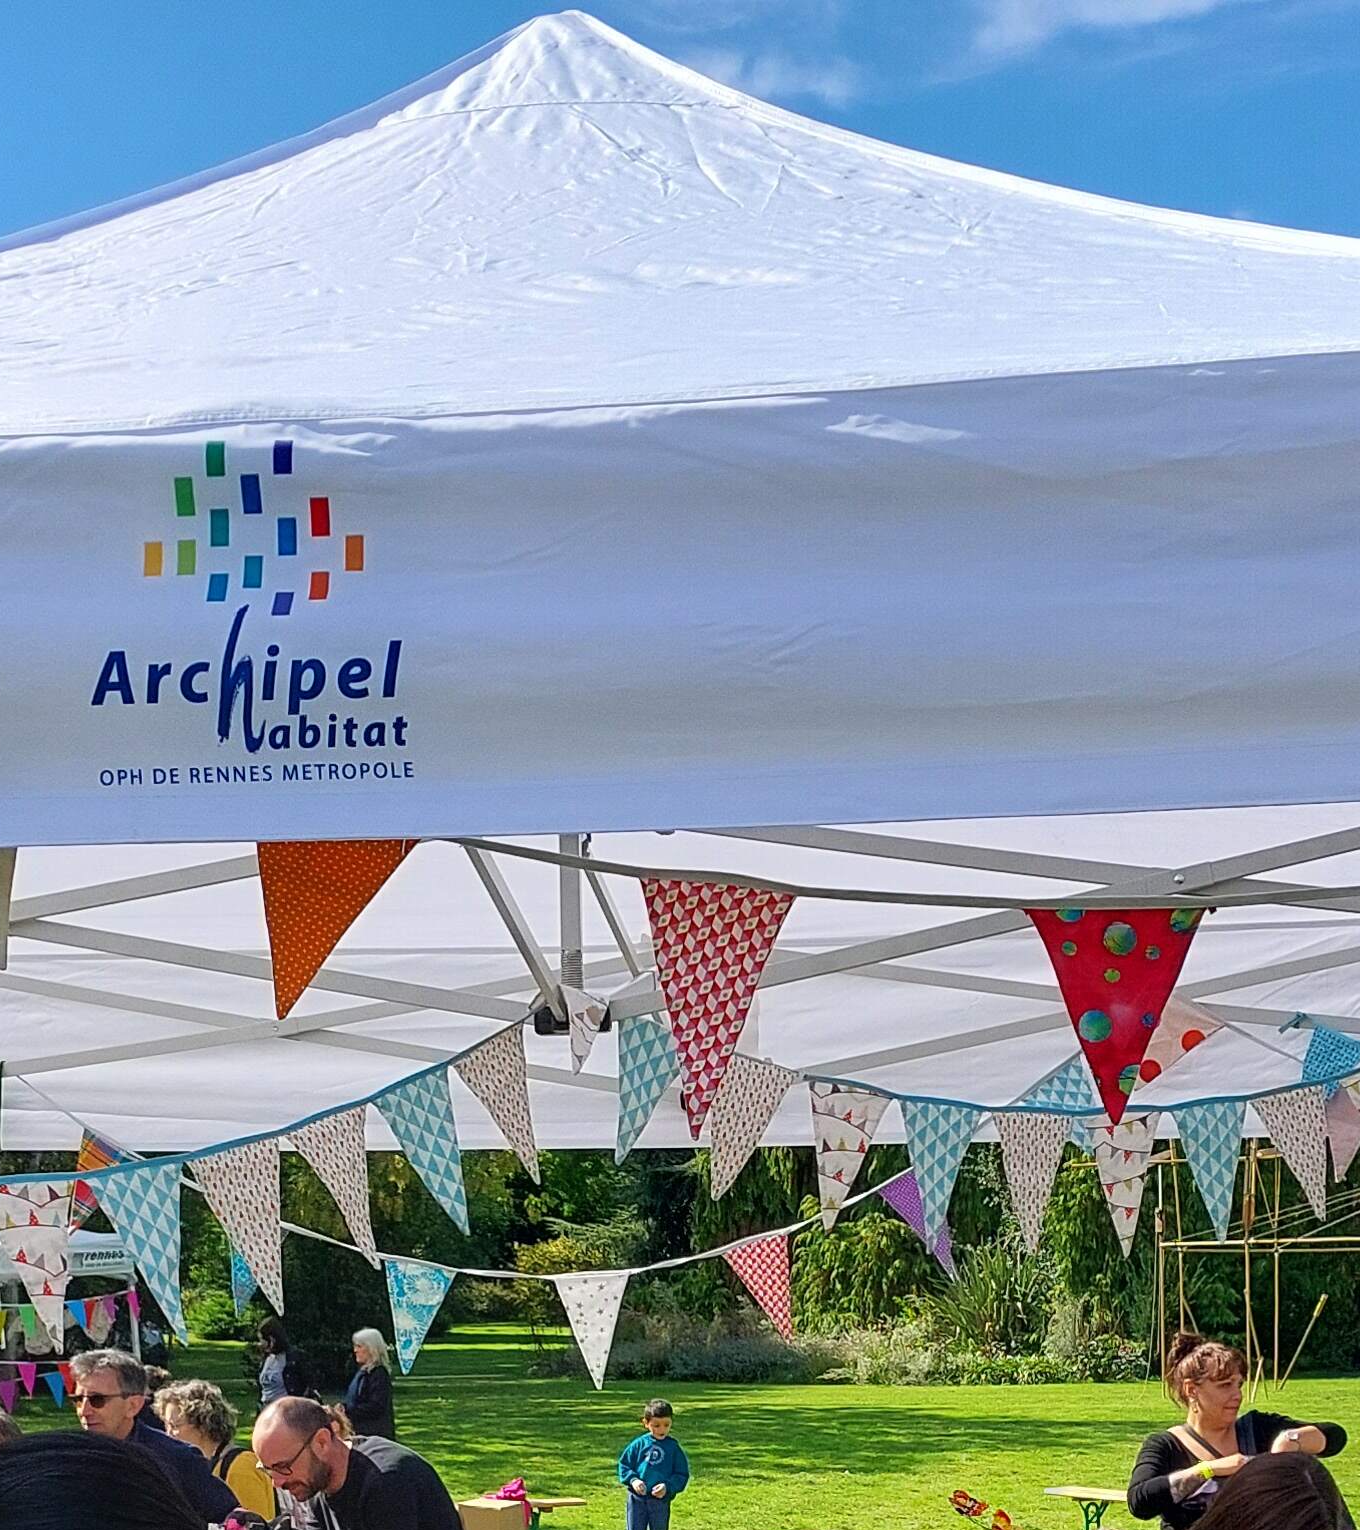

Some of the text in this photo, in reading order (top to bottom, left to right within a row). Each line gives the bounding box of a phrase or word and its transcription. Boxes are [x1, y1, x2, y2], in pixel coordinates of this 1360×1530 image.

[91, 604, 402, 730] Archipel
[99, 762, 414, 786] OPH DE RENNES METROPOLE
